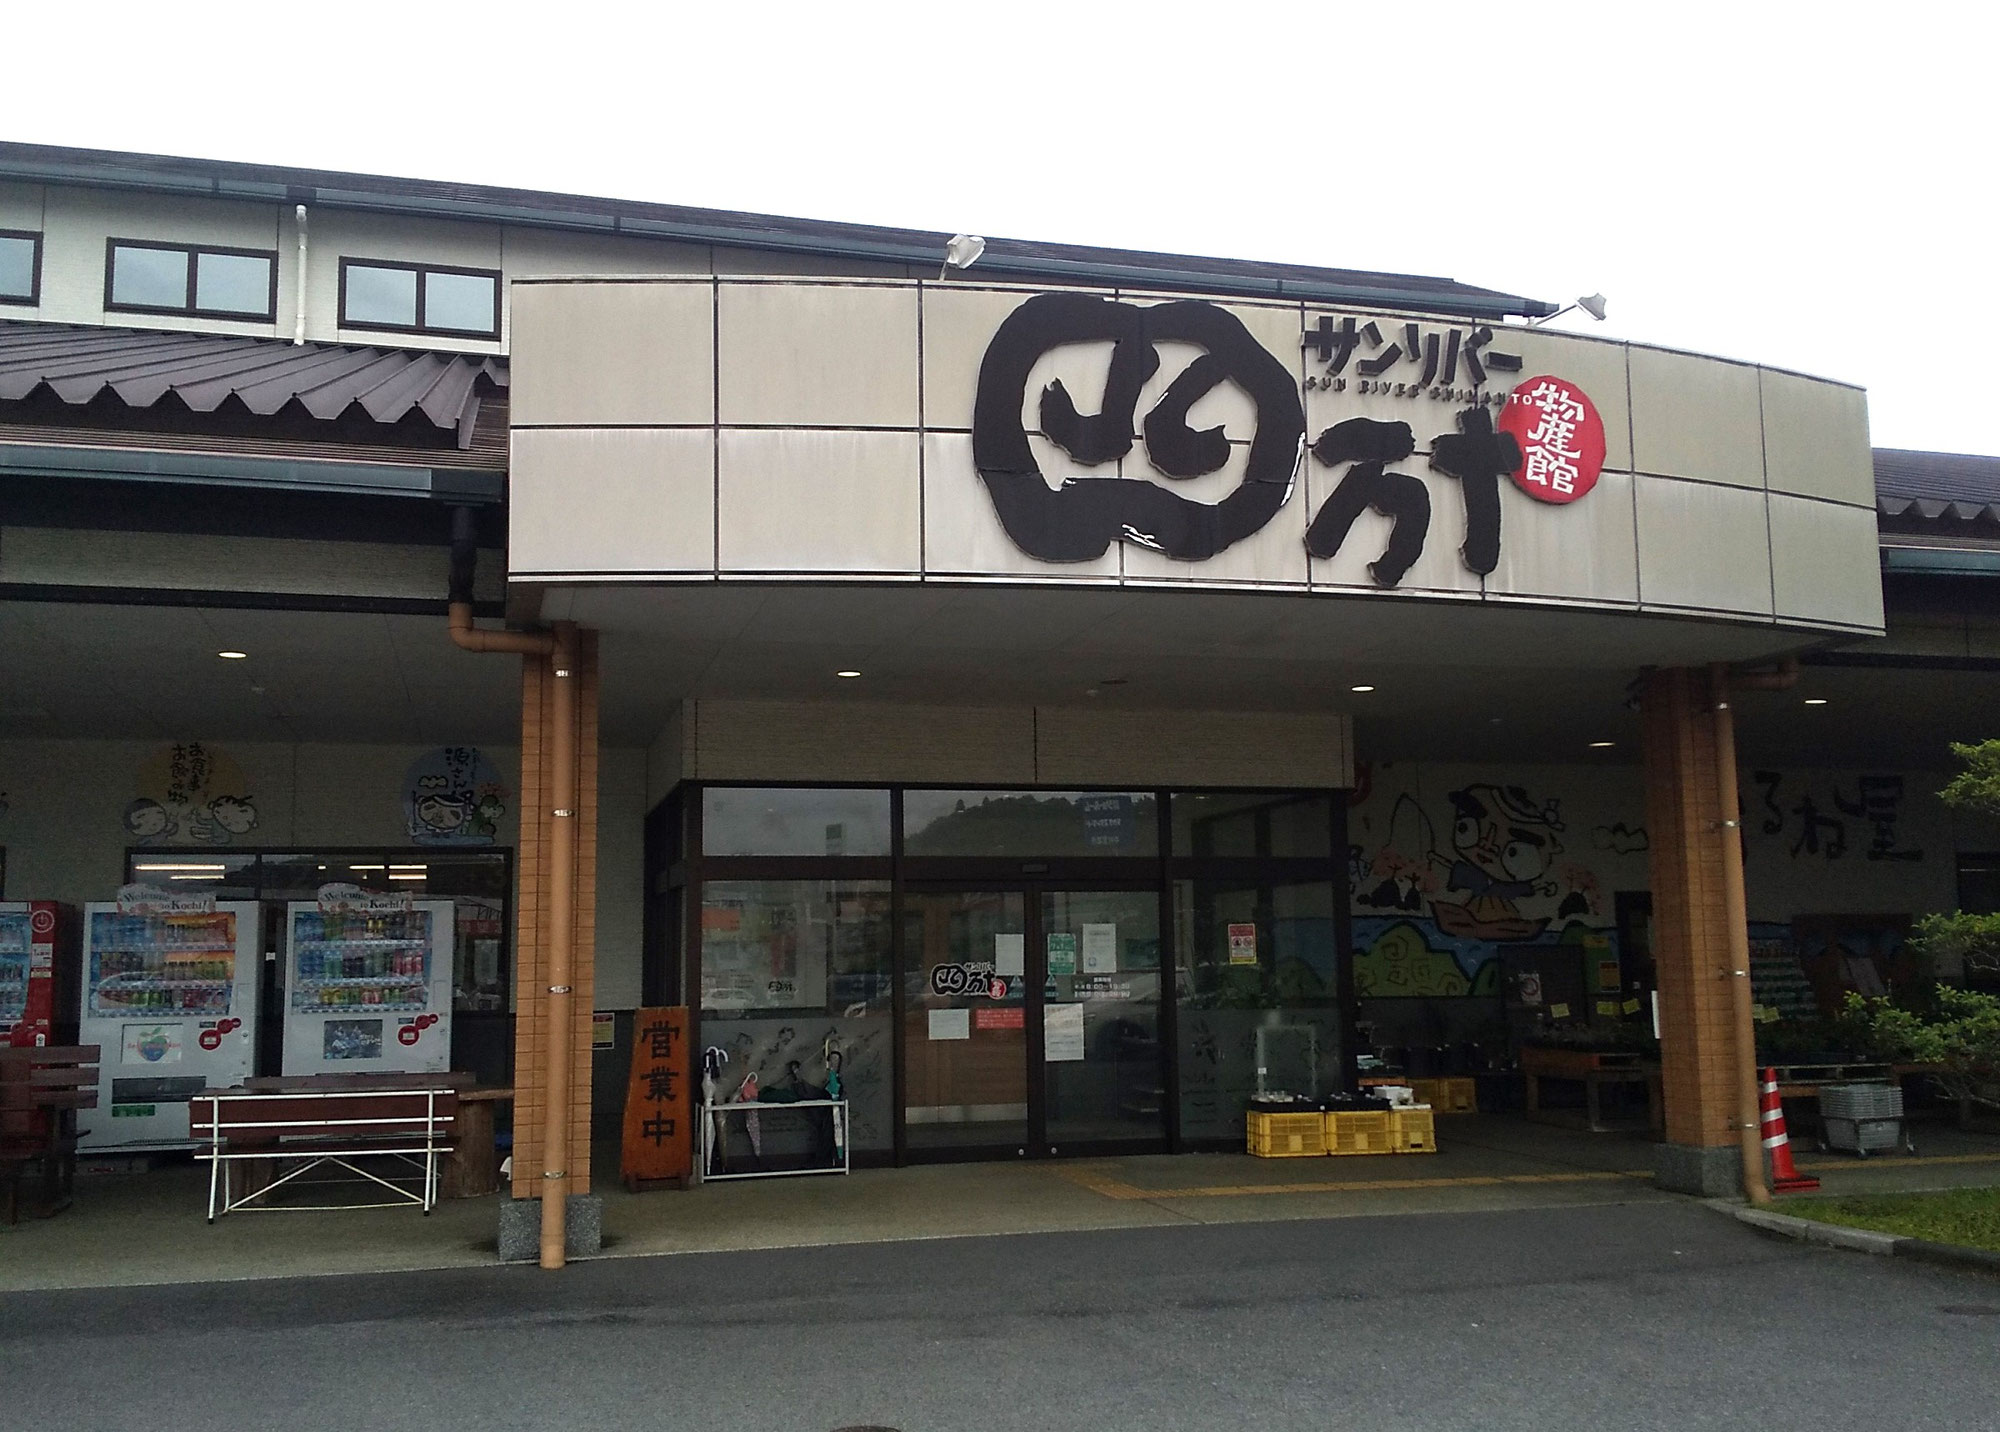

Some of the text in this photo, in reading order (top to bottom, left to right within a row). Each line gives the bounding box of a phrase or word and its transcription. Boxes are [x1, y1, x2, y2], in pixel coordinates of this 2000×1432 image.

[1302, 315, 1523, 390] サンリバー
[1306, 375, 1348, 393] SUN
[1358, 379, 1420, 398] RIVER
[973, 292, 1522, 589] 四万十
[1525, 380, 1586, 495] 物産館
[123, 891, 170, 902] Welcome
[171, 900, 207, 910] Kochi!
[324, 890, 369, 901] Welcome
[370, 899, 404, 909] Kochi!
[641, 1020, 680, 1147] 営業中
